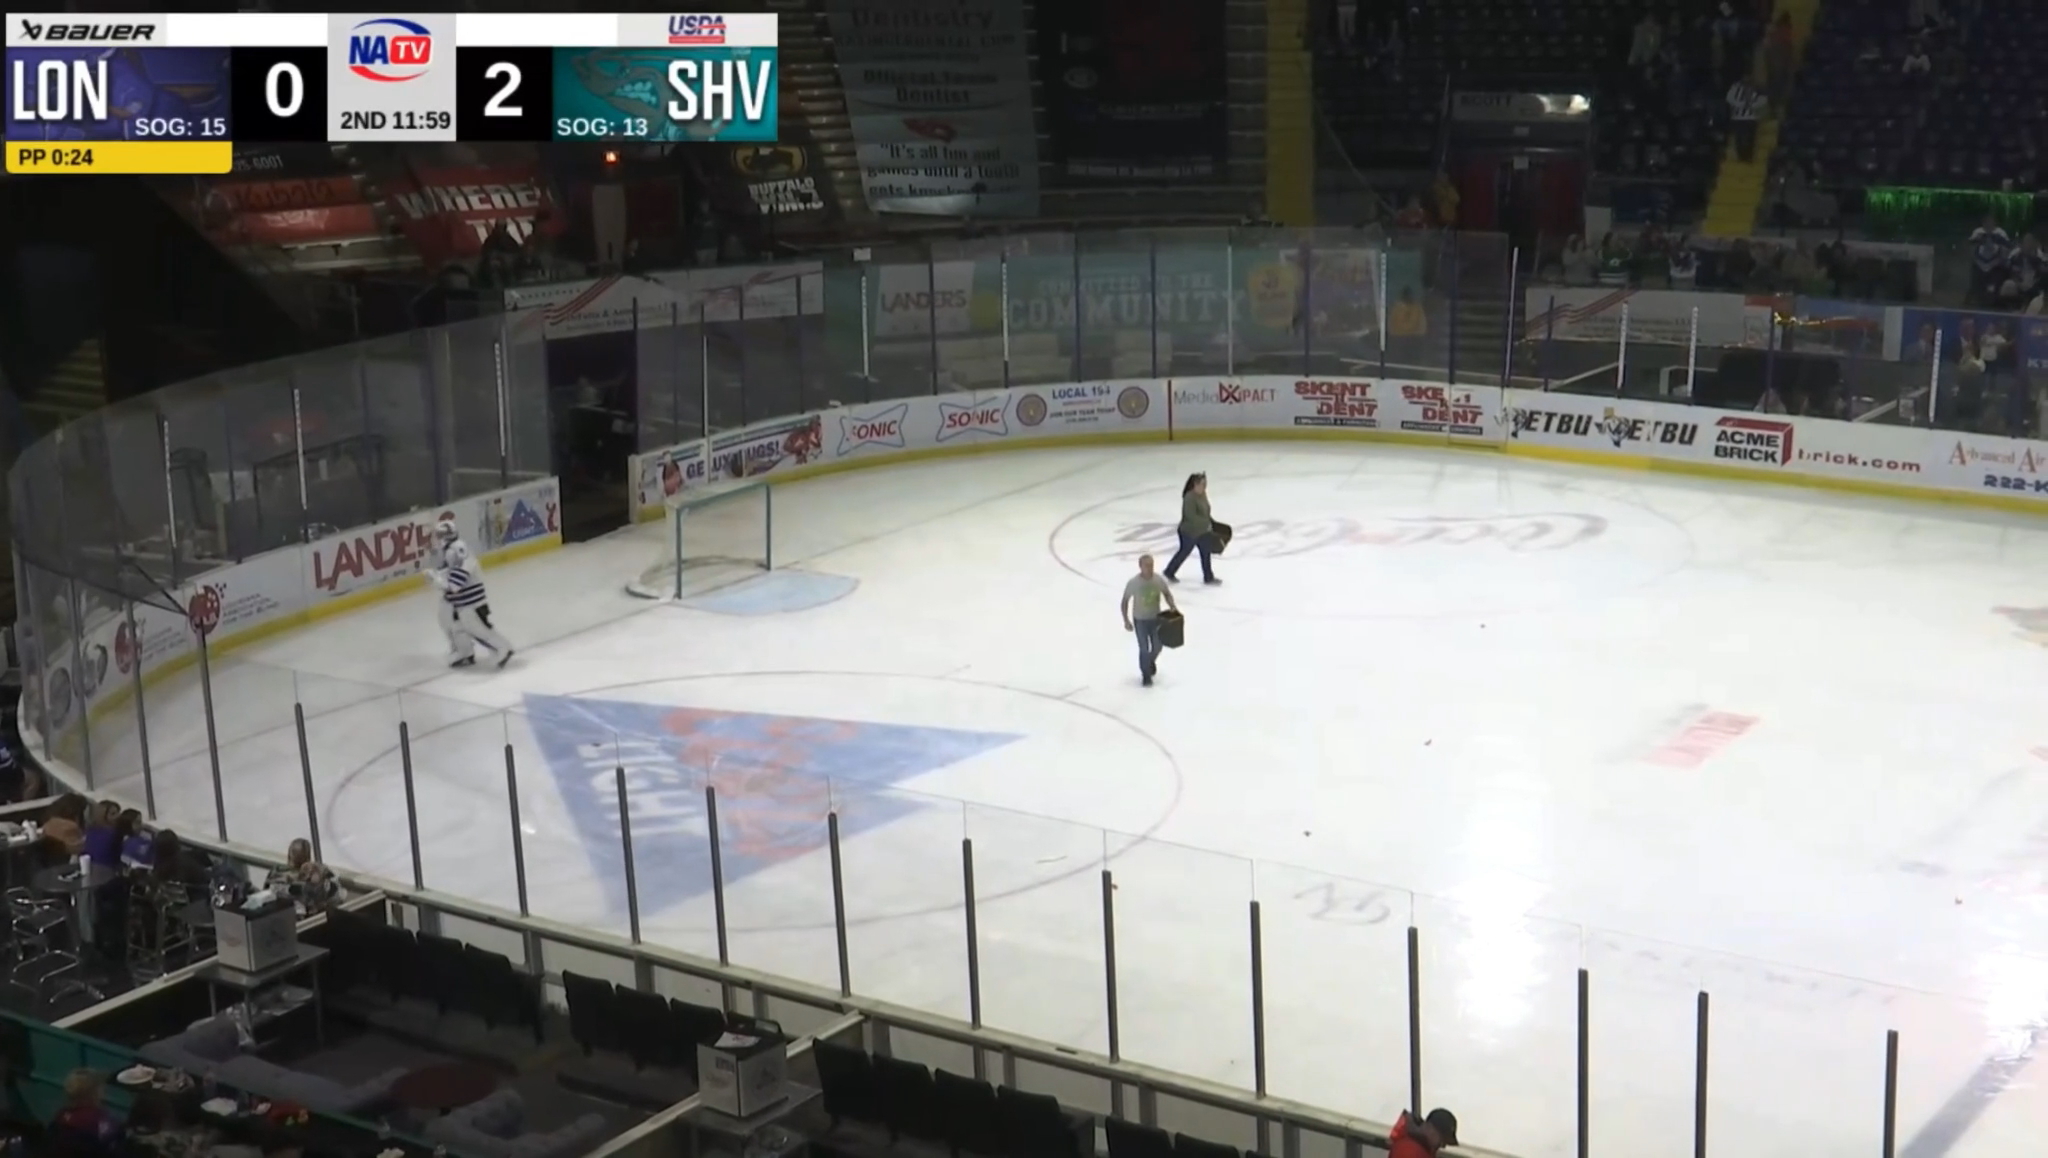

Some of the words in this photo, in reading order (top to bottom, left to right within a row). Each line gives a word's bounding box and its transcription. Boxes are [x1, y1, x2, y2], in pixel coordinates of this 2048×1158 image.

[881, 289, 967, 314] LANDERS
[1052, 387, 1088, 399] LOCAL
[945, 408, 1000, 428] SONIC
[1316, 402, 1378, 422] DENT
[1422, 406, 1483, 424] DENT
[1716, 430, 1780, 448] ACME
[1714, 445, 1778, 463] BRICK
